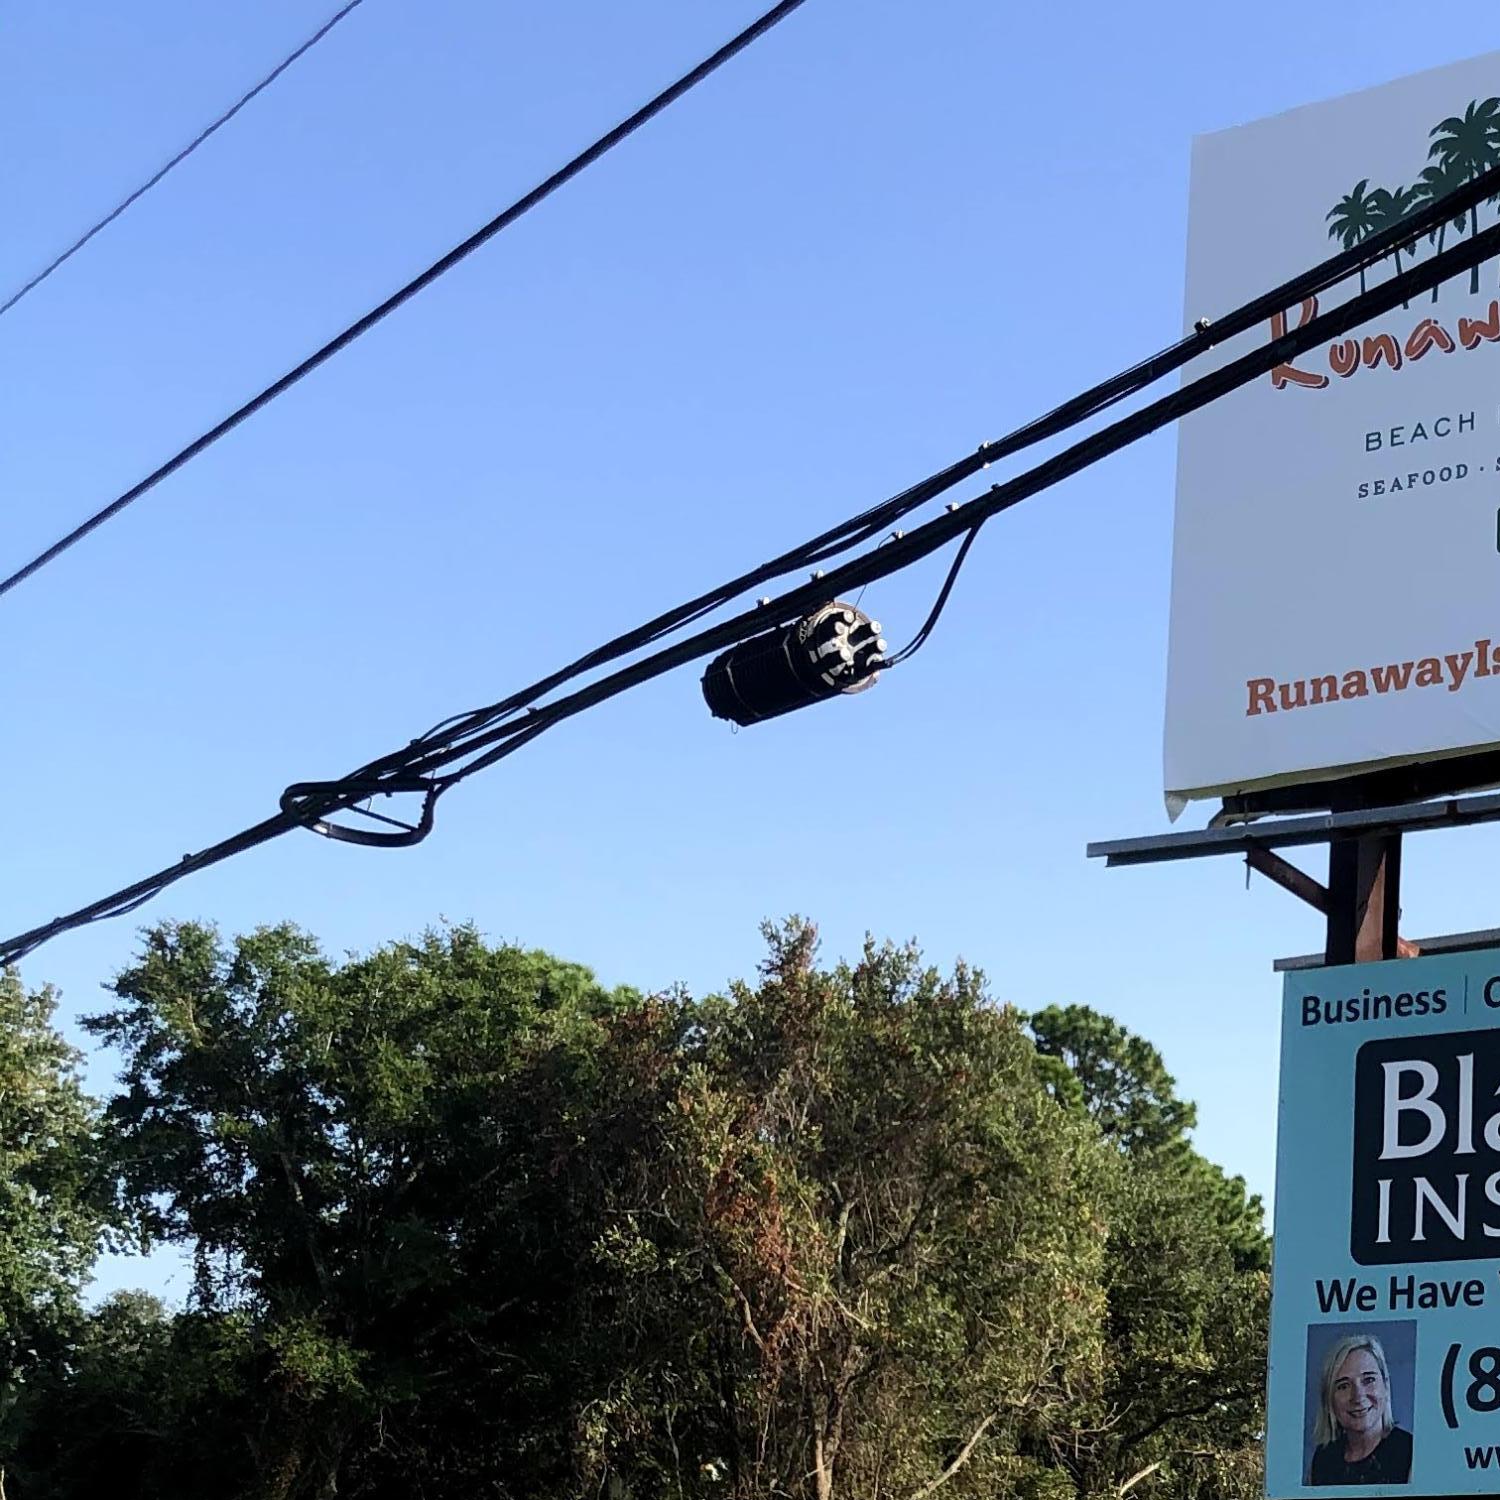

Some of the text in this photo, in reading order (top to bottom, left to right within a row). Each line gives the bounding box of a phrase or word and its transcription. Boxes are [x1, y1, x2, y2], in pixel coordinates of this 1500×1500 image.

[1366, 412, 1474, 451] BEACH
[1359, 464, 1467, 498] SEAFOOD
[1302, 989, 1447, 1026] Business
[1316, 1278, 1377, 1313] We
[1390, 1275, 1484, 1310] Have
